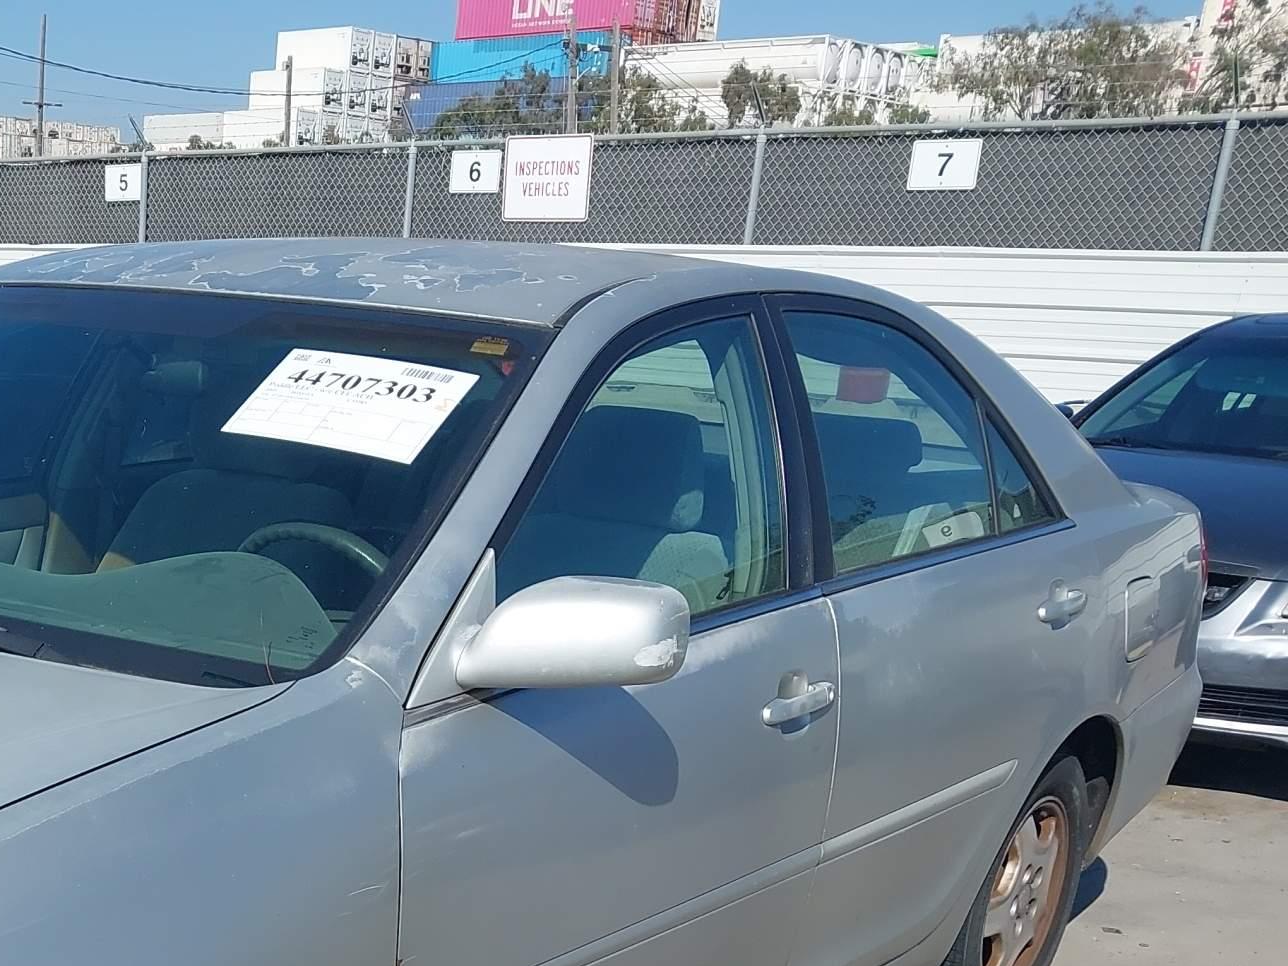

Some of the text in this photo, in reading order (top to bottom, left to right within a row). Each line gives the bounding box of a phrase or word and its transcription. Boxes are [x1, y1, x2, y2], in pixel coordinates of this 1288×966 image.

[469, 161, 481, 182] 6
[515, 160, 580, 177] INSPECTIONS
[938, 152, 954, 177] 7
[119, 173, 128, 192] 5
[521, 181, 570, 197] VEHICLES
[287, 368, 436, 403] 44707303
